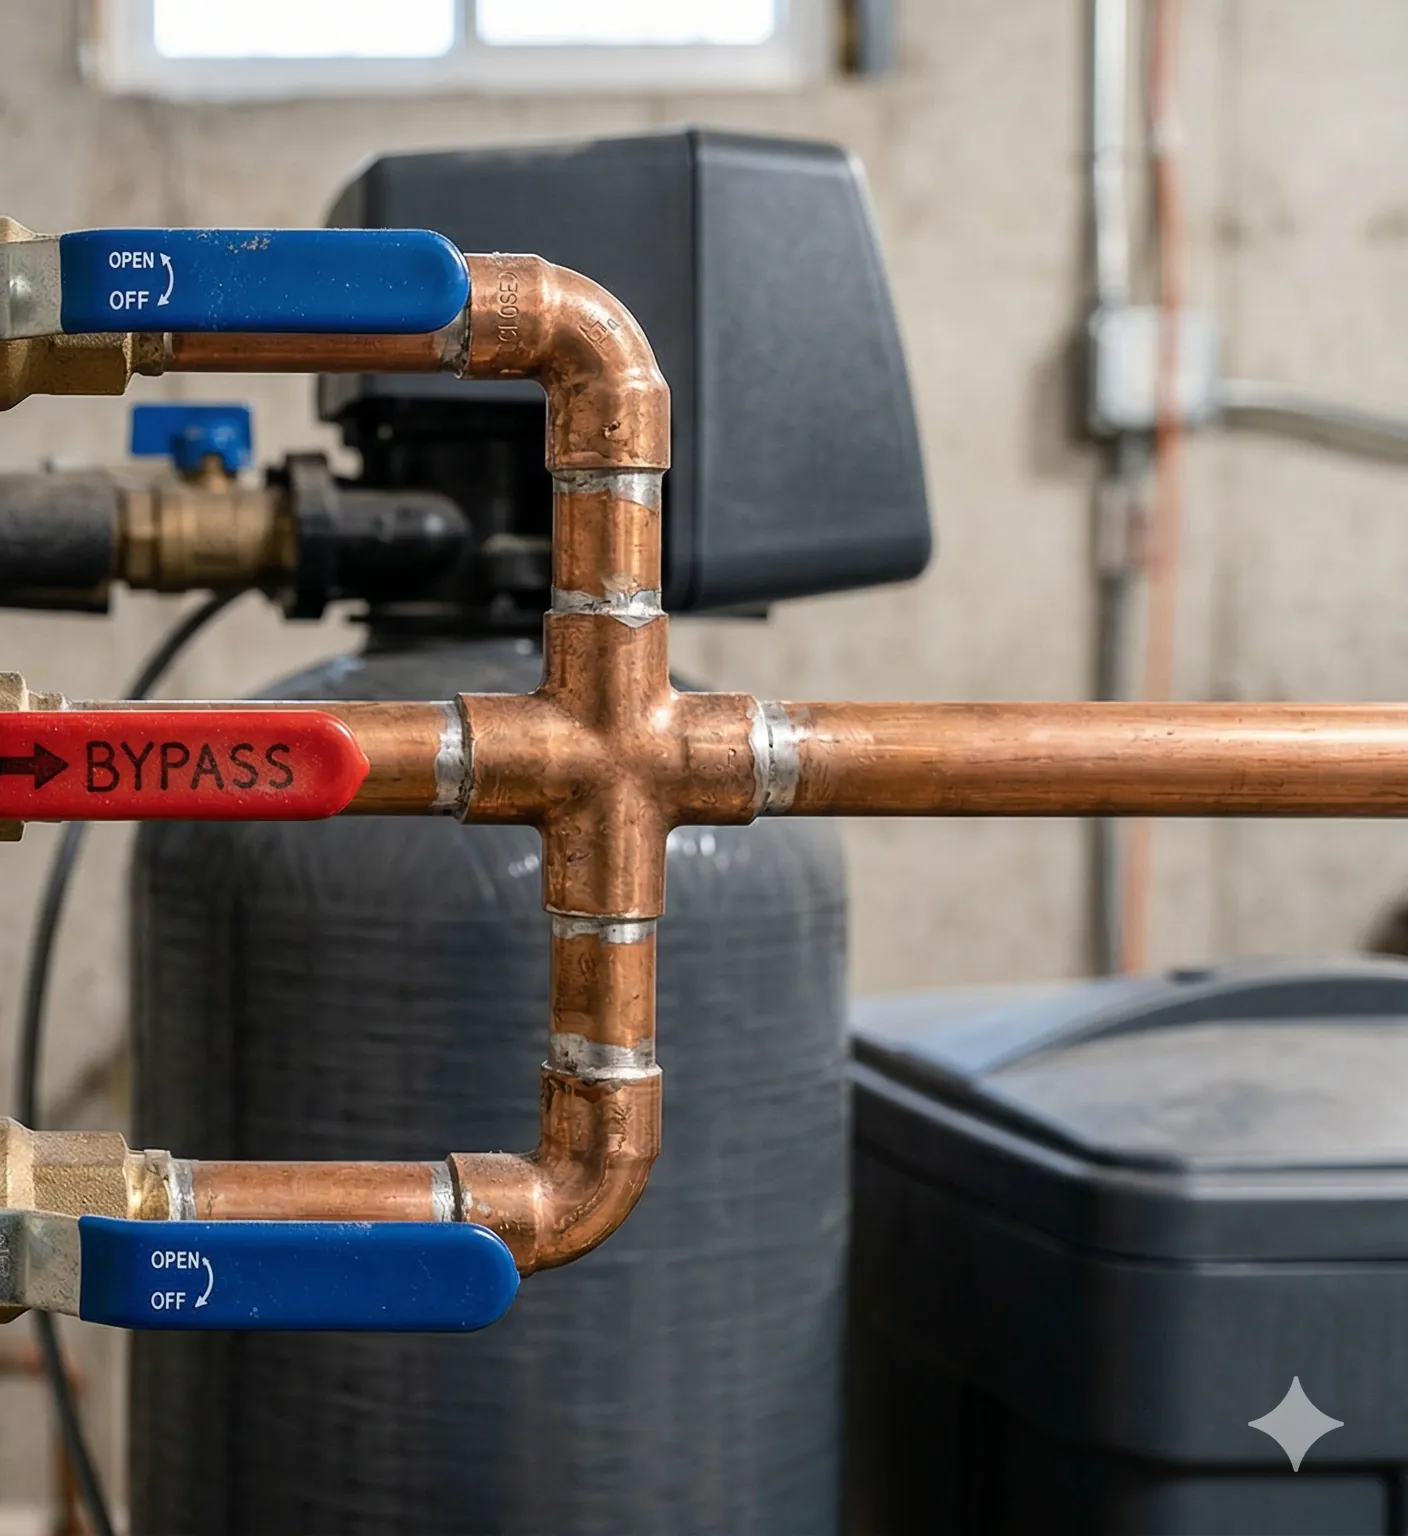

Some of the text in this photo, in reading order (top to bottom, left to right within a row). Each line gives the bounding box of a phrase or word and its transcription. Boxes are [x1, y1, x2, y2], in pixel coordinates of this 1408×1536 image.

[108, 251, 155, 269] OPEN
[108, 290, 150, 310] OFF
[86, 740, 294, 793] BYPASS
[150, 1250, 200, 1269] OPEN
[150, 1291, 186, 1310] OFF
